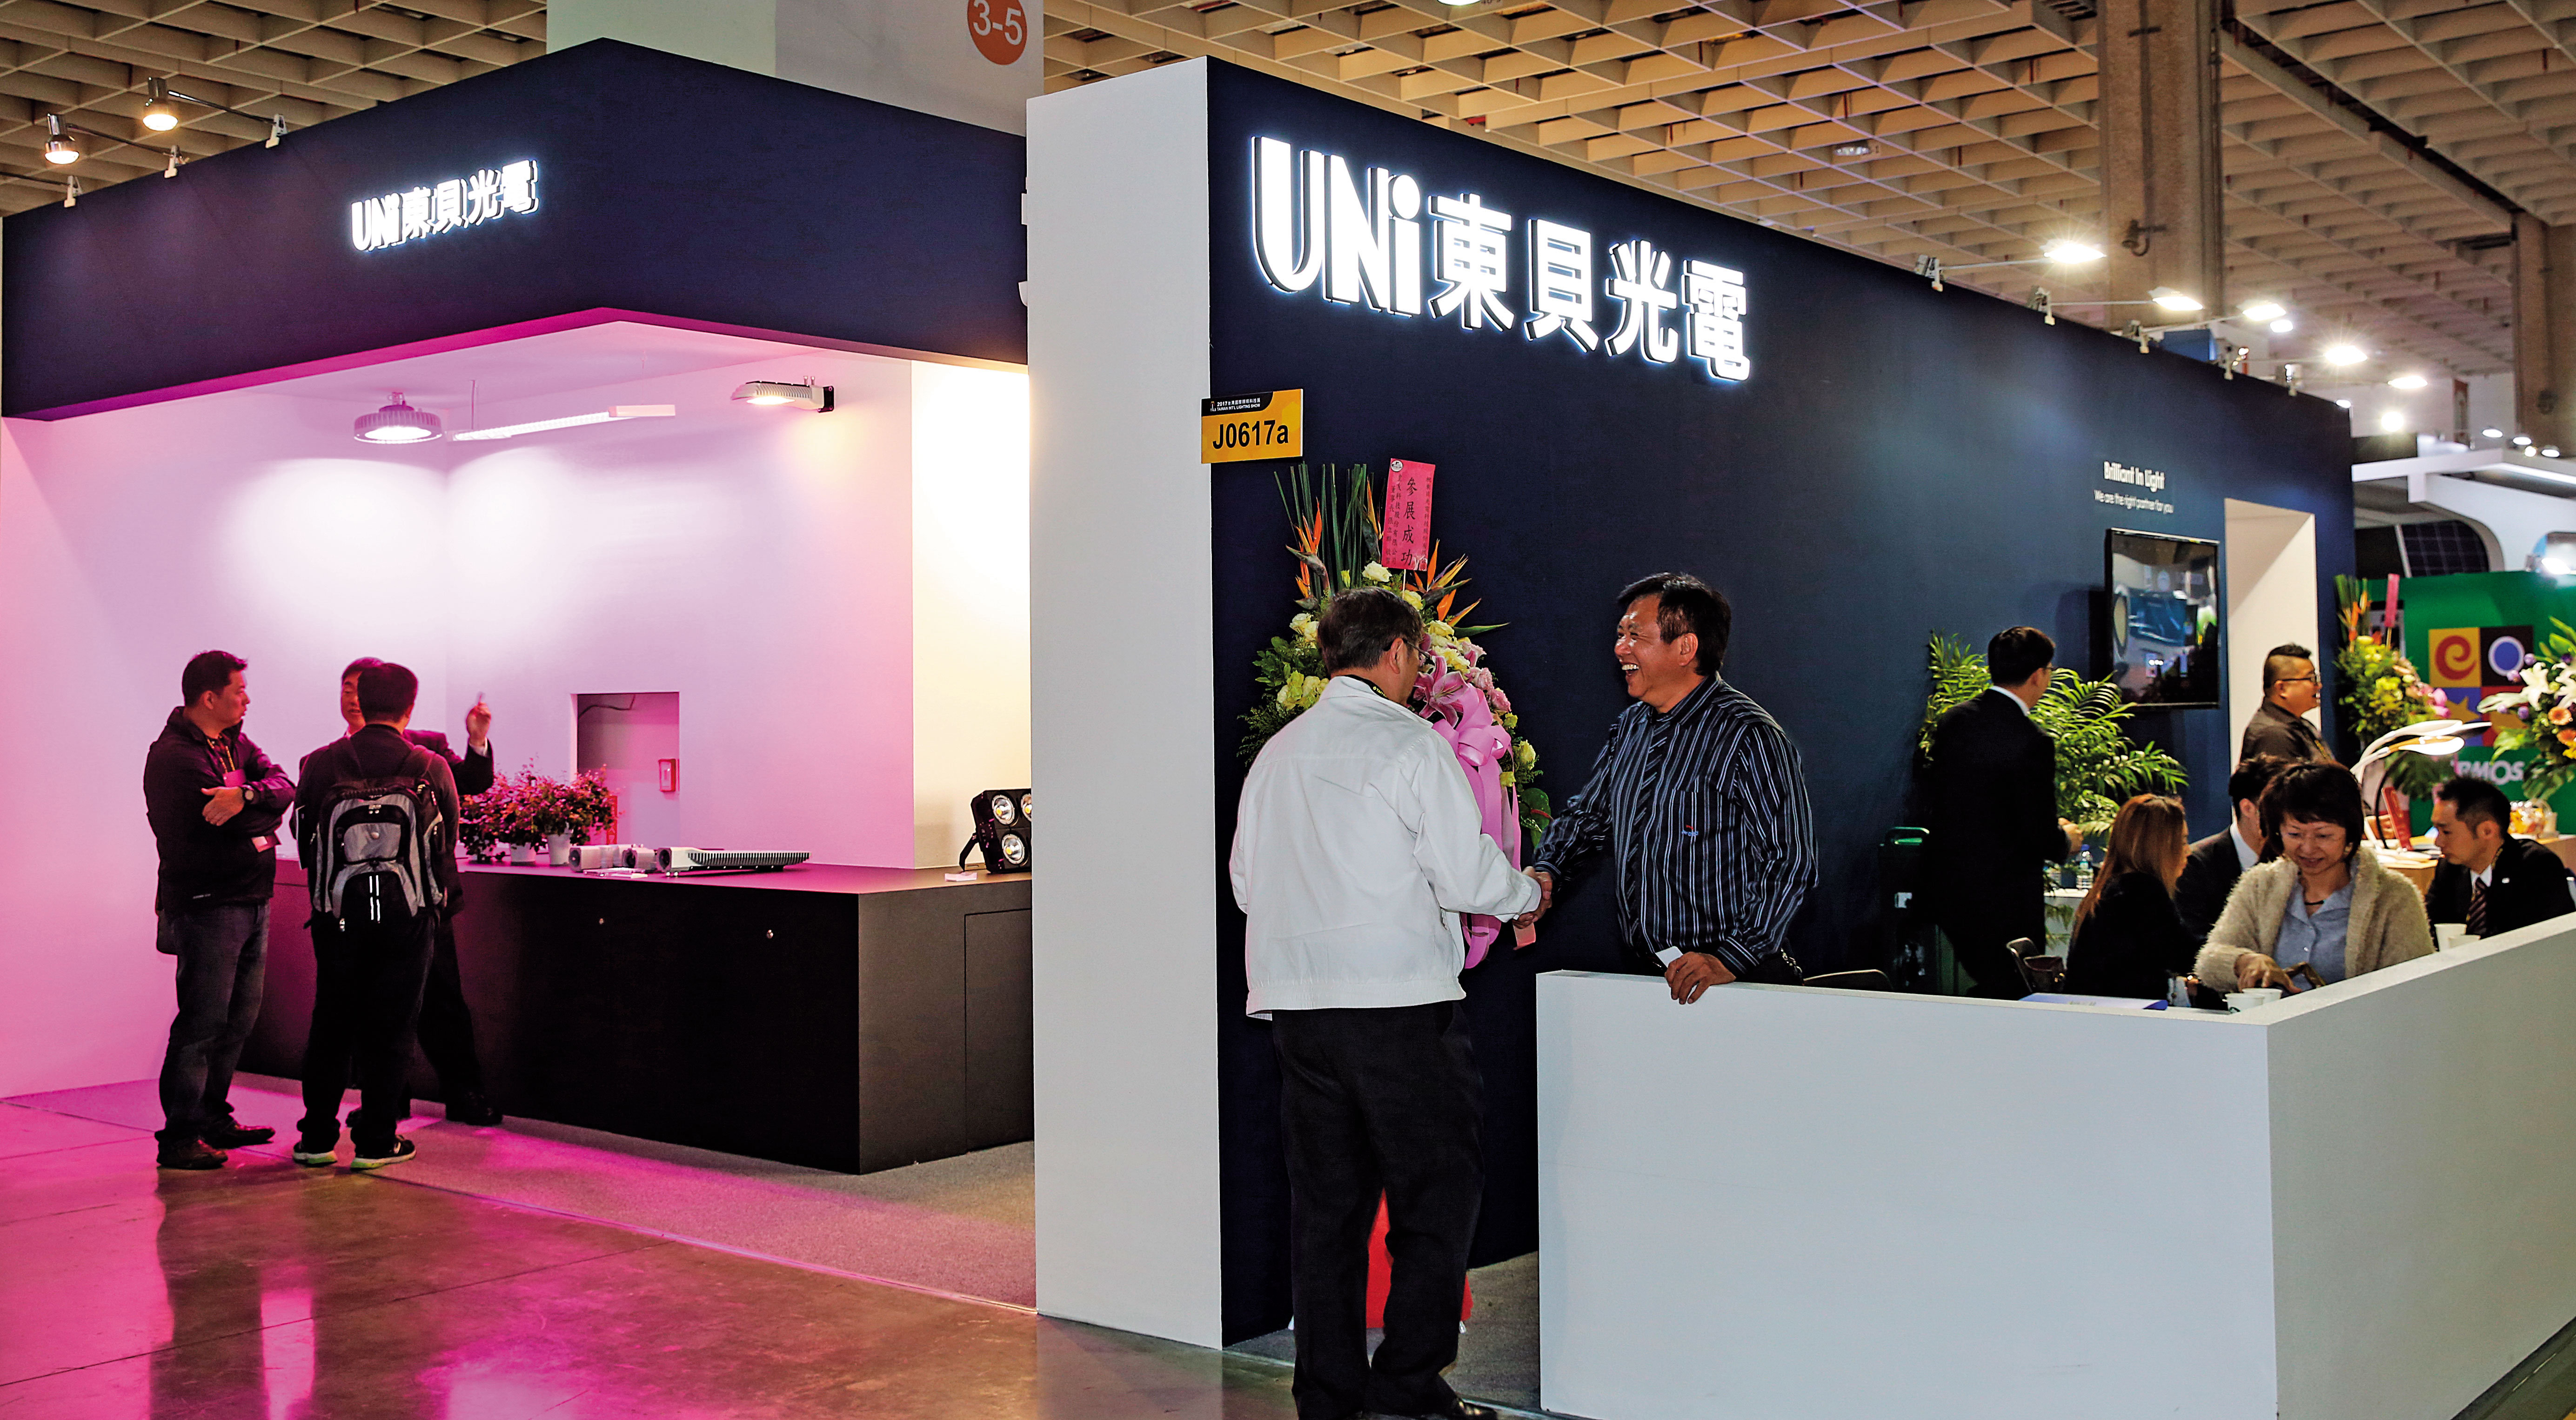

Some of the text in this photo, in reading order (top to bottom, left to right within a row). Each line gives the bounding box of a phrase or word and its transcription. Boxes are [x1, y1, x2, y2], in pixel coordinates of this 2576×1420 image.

[973, 0, 1023, 45] 3-5
[1212, 420, 1289, 449] J0617a
[1401, 477, 1418, 566] 參展成功
